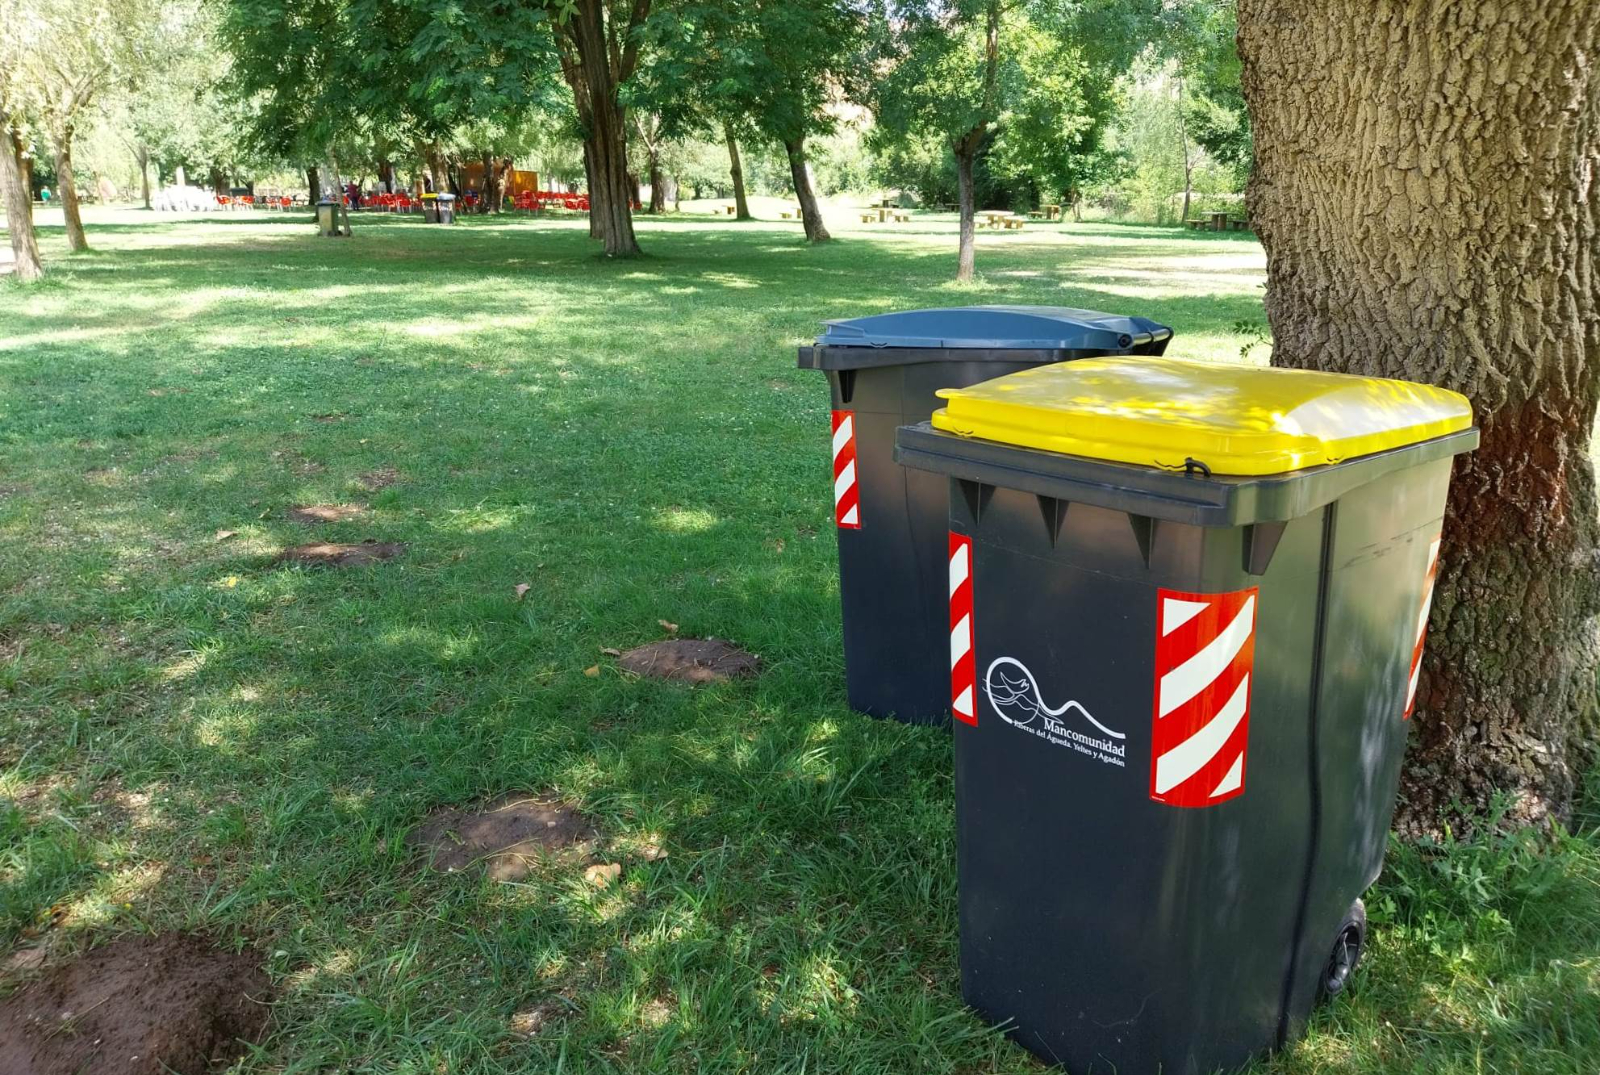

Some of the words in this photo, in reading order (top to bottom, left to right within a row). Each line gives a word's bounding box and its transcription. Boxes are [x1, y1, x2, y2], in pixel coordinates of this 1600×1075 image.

[1036, 729, 1046, 739] del
[1073, 742, 1092, 756] Yeltes
[1093, 751, 1098, 759] y
[1098, 752, 1125, 767] Agadón
[1044, 718, 1125, 757] Mancomunidad
